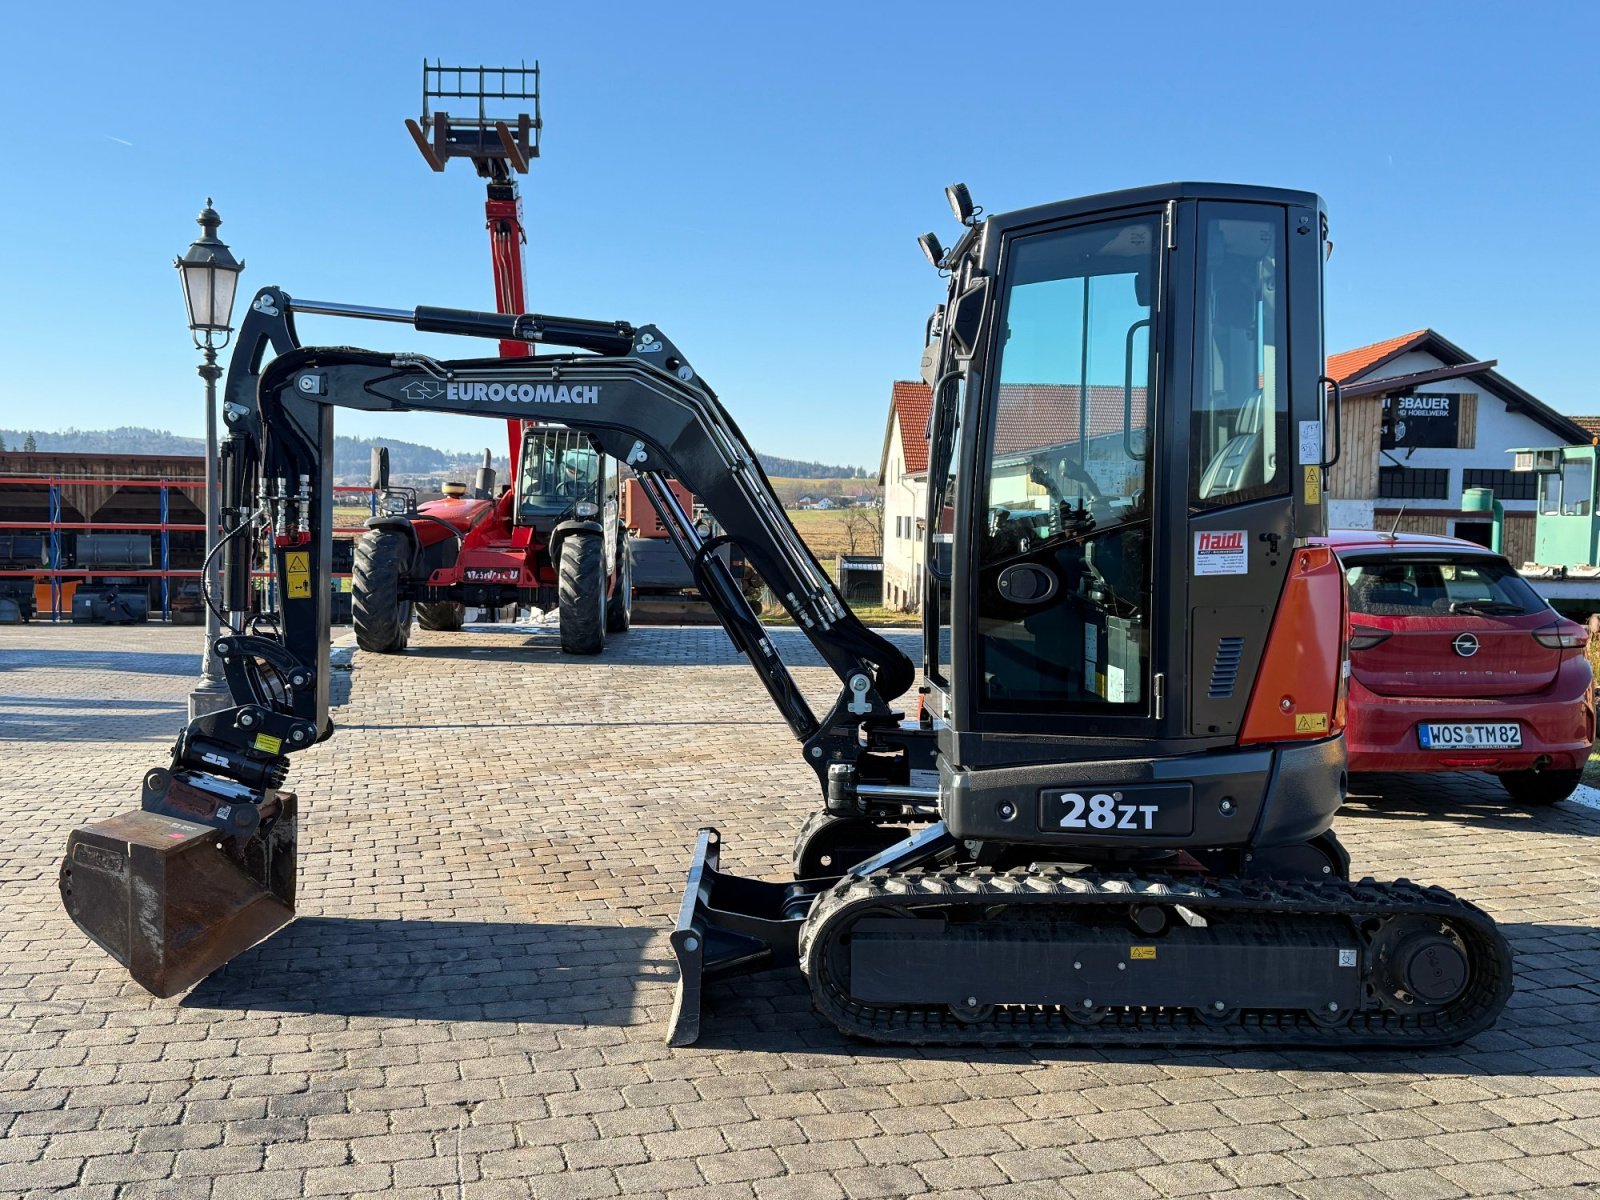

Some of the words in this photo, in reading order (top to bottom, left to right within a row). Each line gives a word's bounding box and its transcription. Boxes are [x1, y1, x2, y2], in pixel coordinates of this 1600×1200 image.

[447, 382, 598, 404] EUROCOMACH
[1382, 397, 1450, 409] GBAUER
[1408, 409, 1449, 417] HOBELWERK
[1199, 532, 1243, 550] Haidl
[1430, 726, 1463, 743] WOS
[1060, 793, 1159, 830] 28ZT
